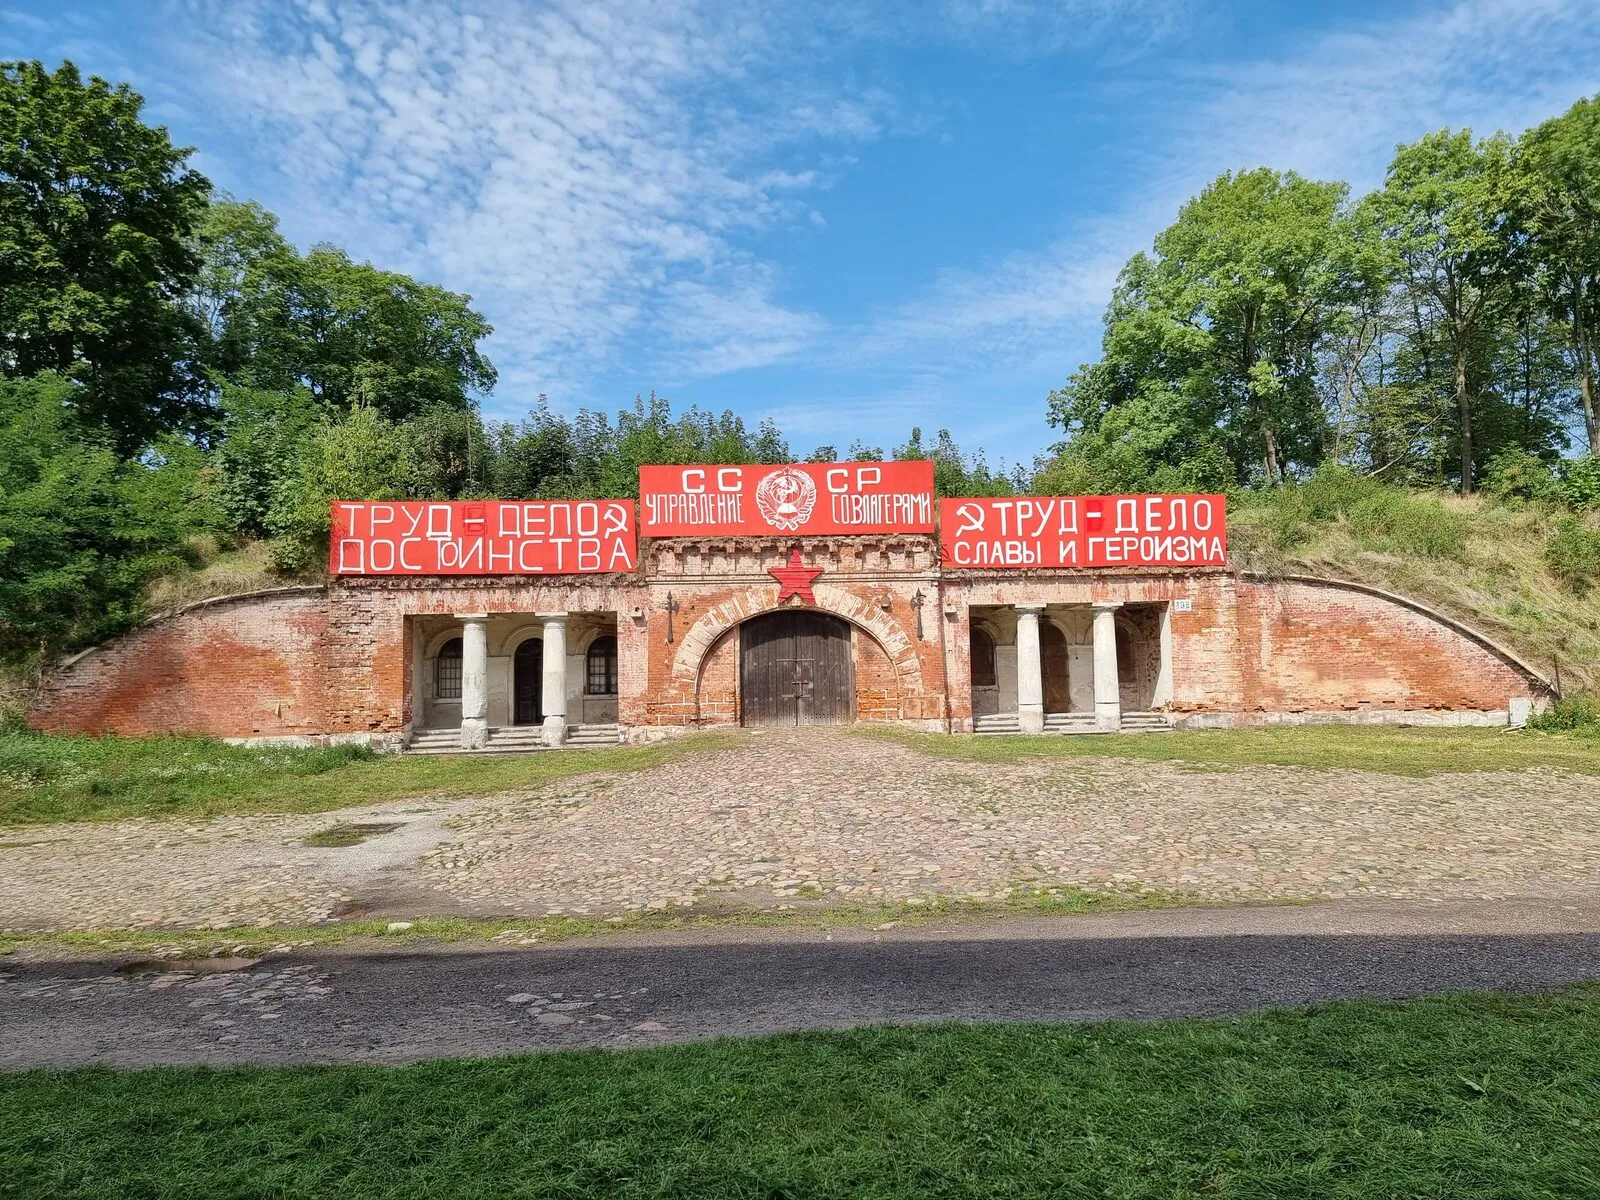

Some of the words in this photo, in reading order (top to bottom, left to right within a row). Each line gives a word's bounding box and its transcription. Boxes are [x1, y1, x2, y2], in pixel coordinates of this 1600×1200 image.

[340, 504, 452, 537] ТРУД
[498, 503, 599, 538] ДЕЛО
[645, 493, 745, 525] УПРАВЛЕНИЕ
[831, 492, 932, 525] СОВЛАГЕРЯМИ
[992, 500, 1078, 537] ТРУД
[1115, 497, 1212, 534] ДЕЛО
[338, 537, 633, 574] ДОСТОИНСТВА
[954, 540, 1042, 565] СЛАВЫ
[1059, 541, 1077, 564] И
[1088, 535, 1226, 562] ГЕРОИЗМА
